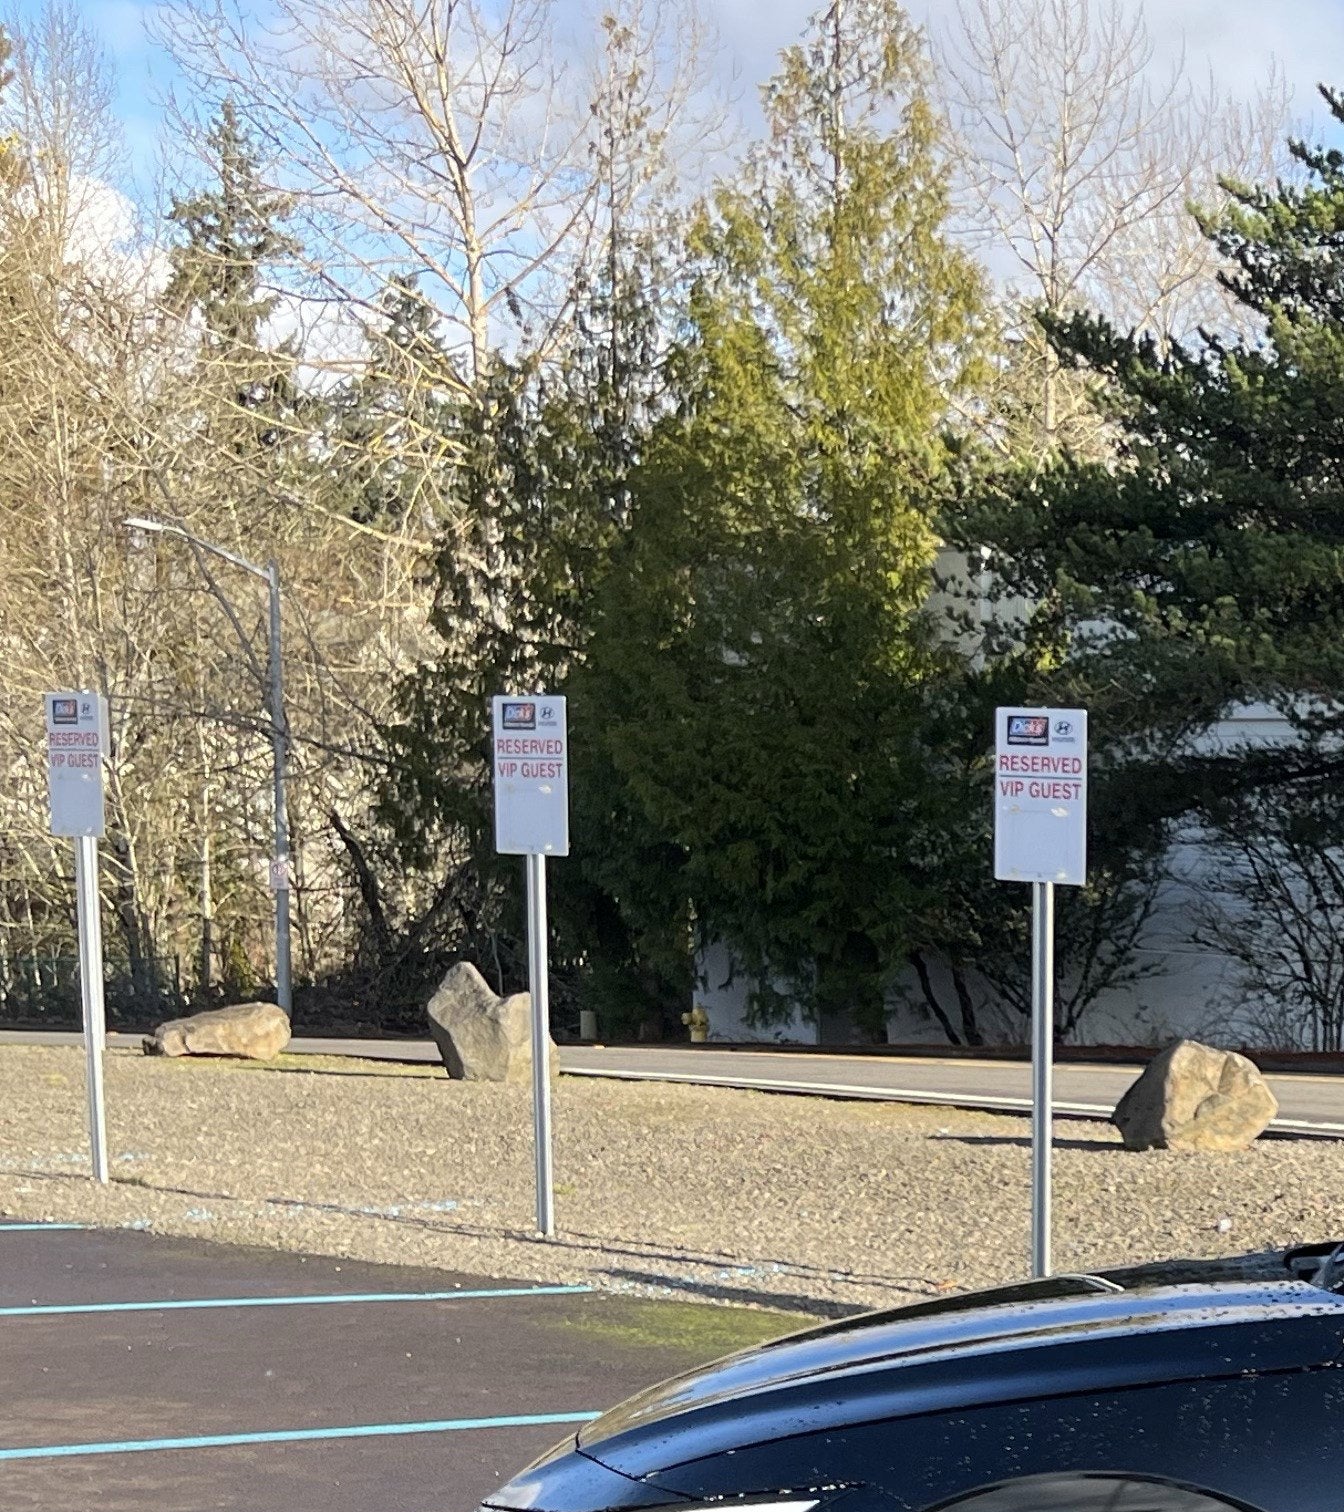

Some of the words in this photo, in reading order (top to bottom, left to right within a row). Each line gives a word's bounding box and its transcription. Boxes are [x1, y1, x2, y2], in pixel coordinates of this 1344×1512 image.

[49, 732, 99, 747] RESERVED
[497, 739, 563, 755] RESERVED
[50, 754, 65, 767] VIP
[67, 754, 98, 768] GUEST
[999, 755, 1082, 774] RESERVED
[498, 763, 517, 778] VIP
[521, 762, 563, 779] GUEST
[1000, 781, 1024, 797] VIP
[1029, 782, 1081, 800] GUEST
